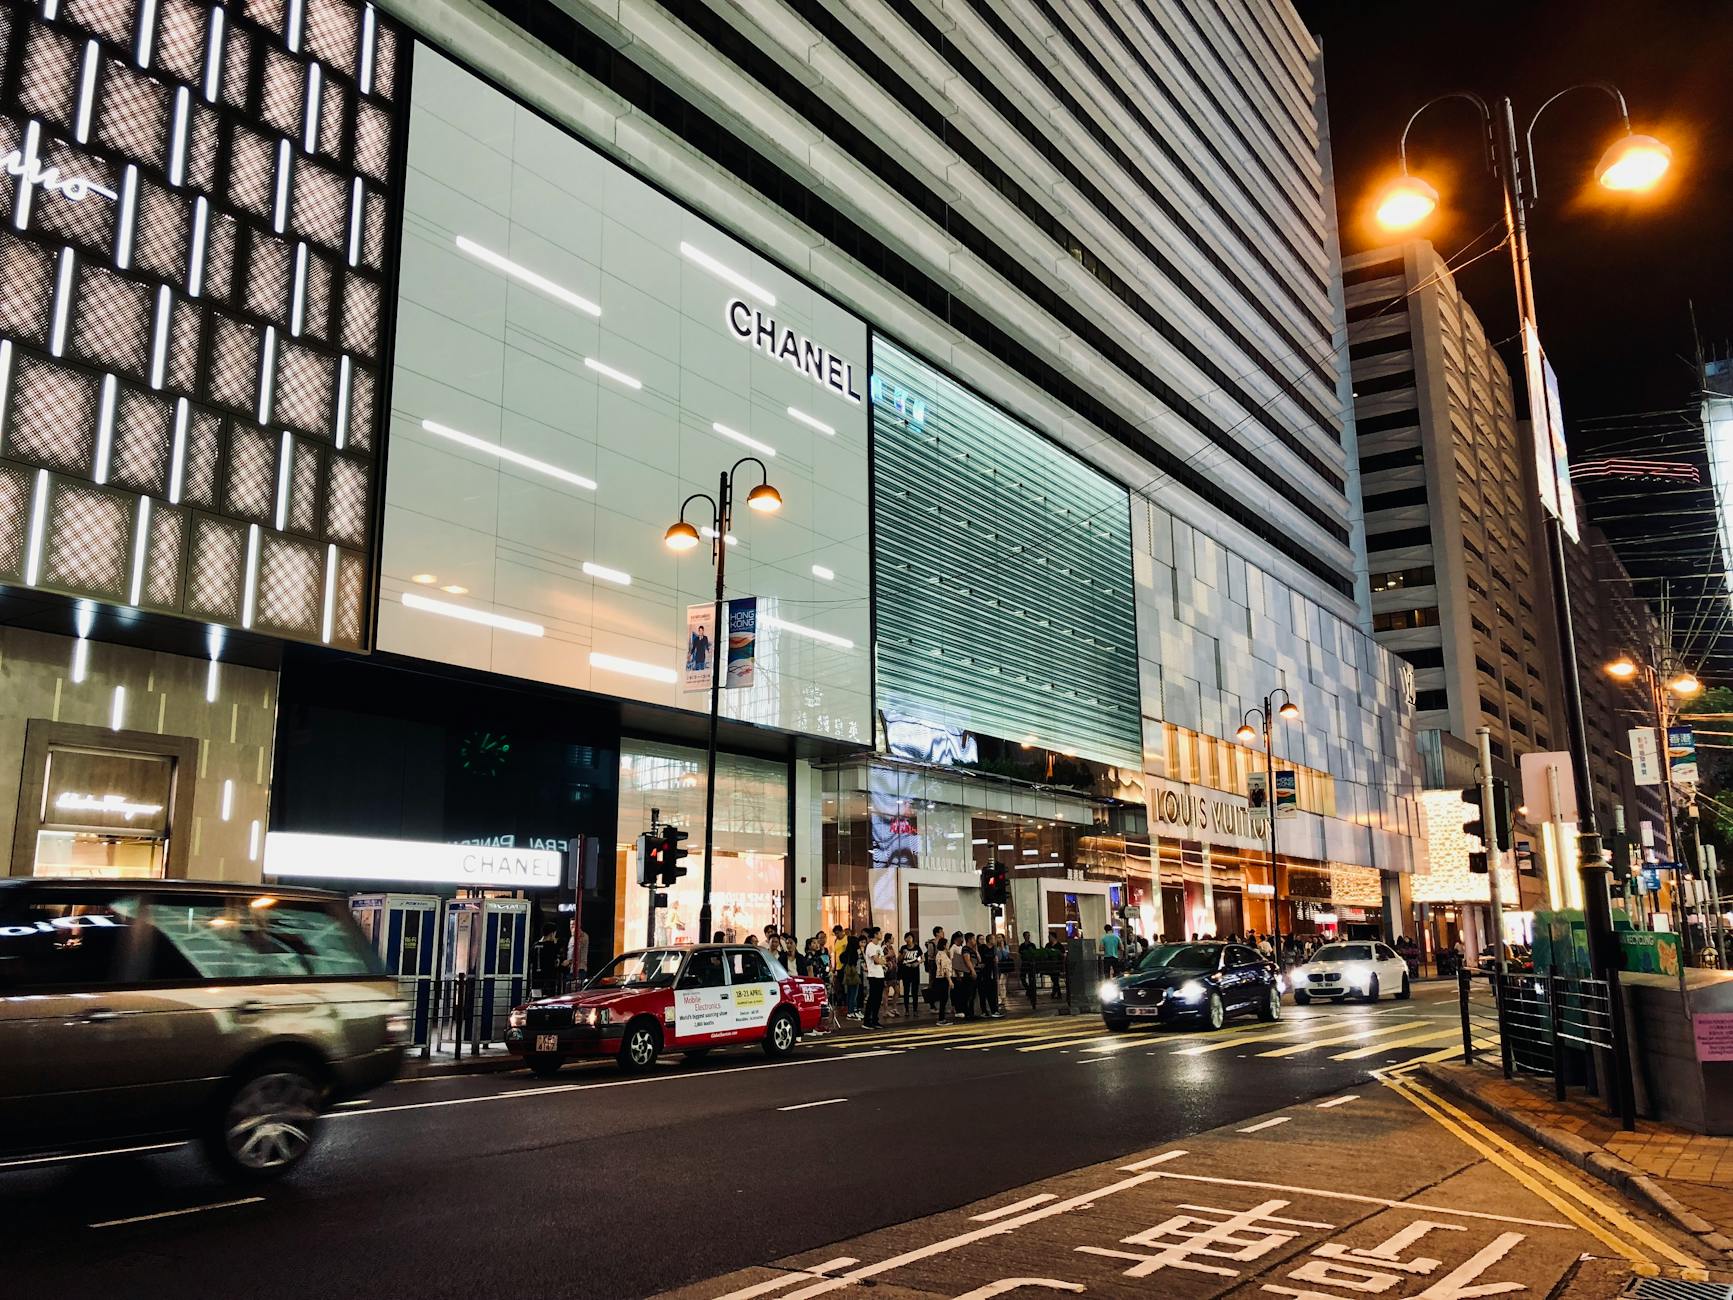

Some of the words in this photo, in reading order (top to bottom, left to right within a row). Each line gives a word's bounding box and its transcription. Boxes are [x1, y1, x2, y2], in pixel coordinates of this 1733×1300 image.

[728, 299, 862, 403] CHANEL
[730, 610, 755, 621] HONG
[730, 618, 755, 629] KONG
[1150, 787, 1208, 830] LOUIS
[462, 854, 557, 877] CHANEL
[1626, 935, 1655, 945] RECYCLING
[684, 996, 701, 1005] Mobile
[694, 1002, 721, 1011] Electronics
